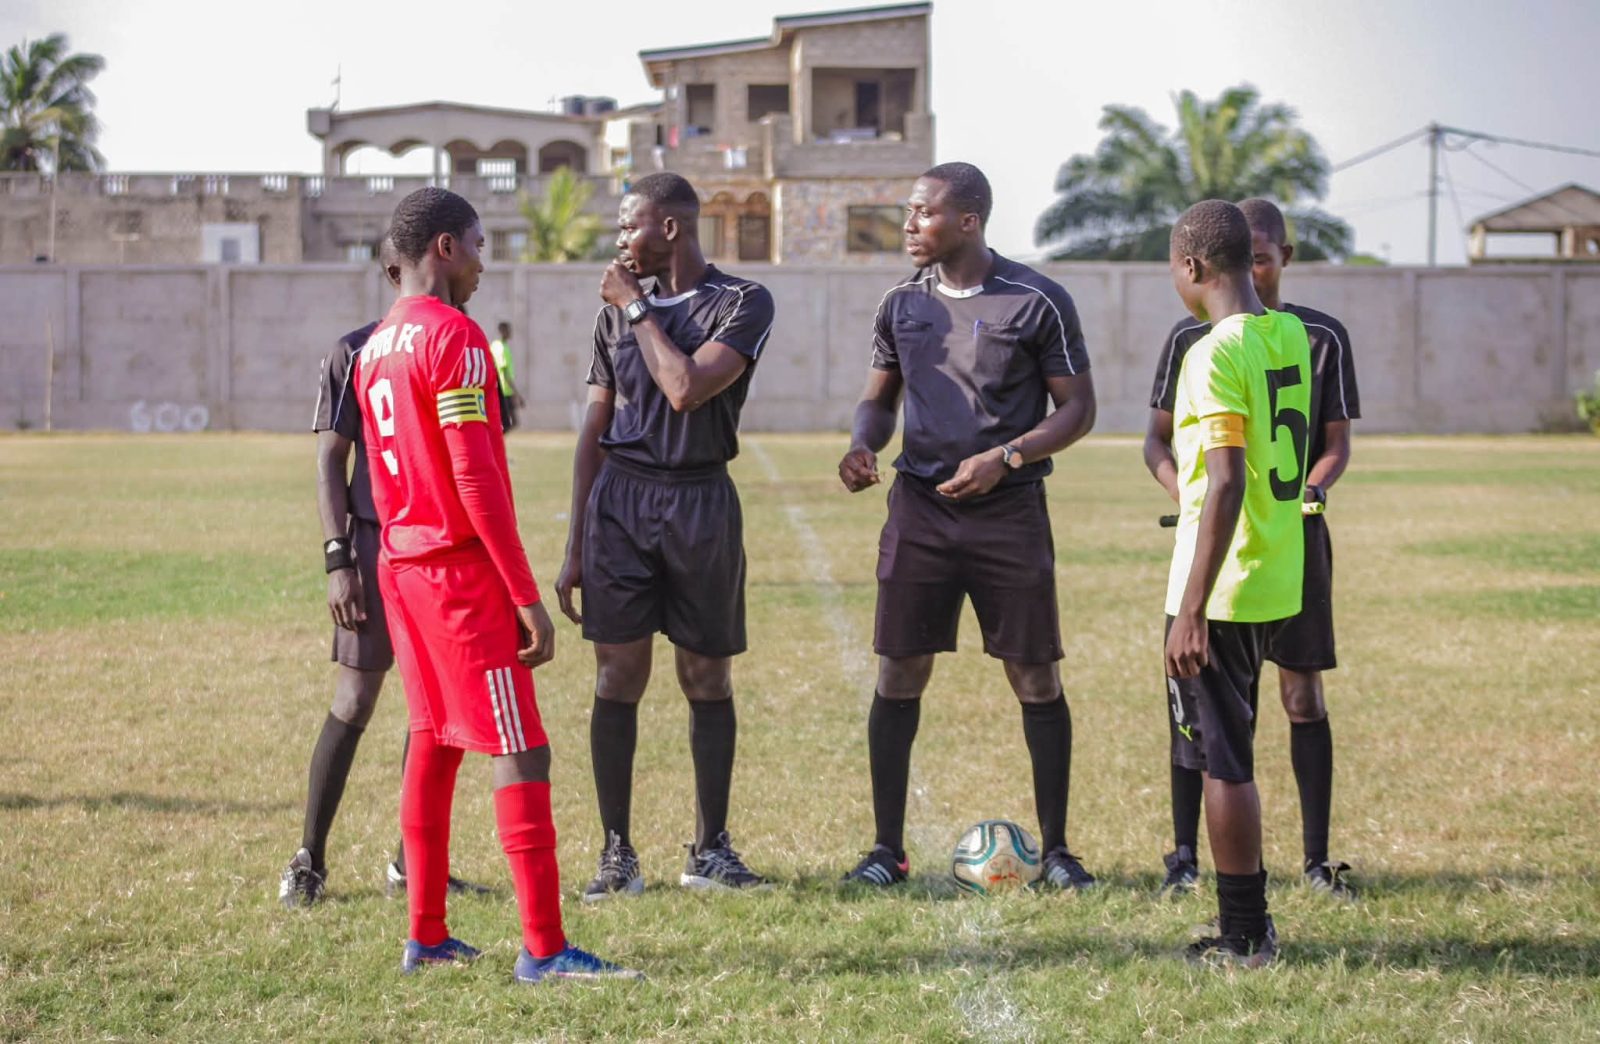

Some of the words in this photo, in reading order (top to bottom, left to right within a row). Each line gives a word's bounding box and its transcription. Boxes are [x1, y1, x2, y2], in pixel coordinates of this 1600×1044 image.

[395, 323, 423, 353] FC
[368, 378, 399, 476] 9
[1265, 364, 1308, 501] 5
